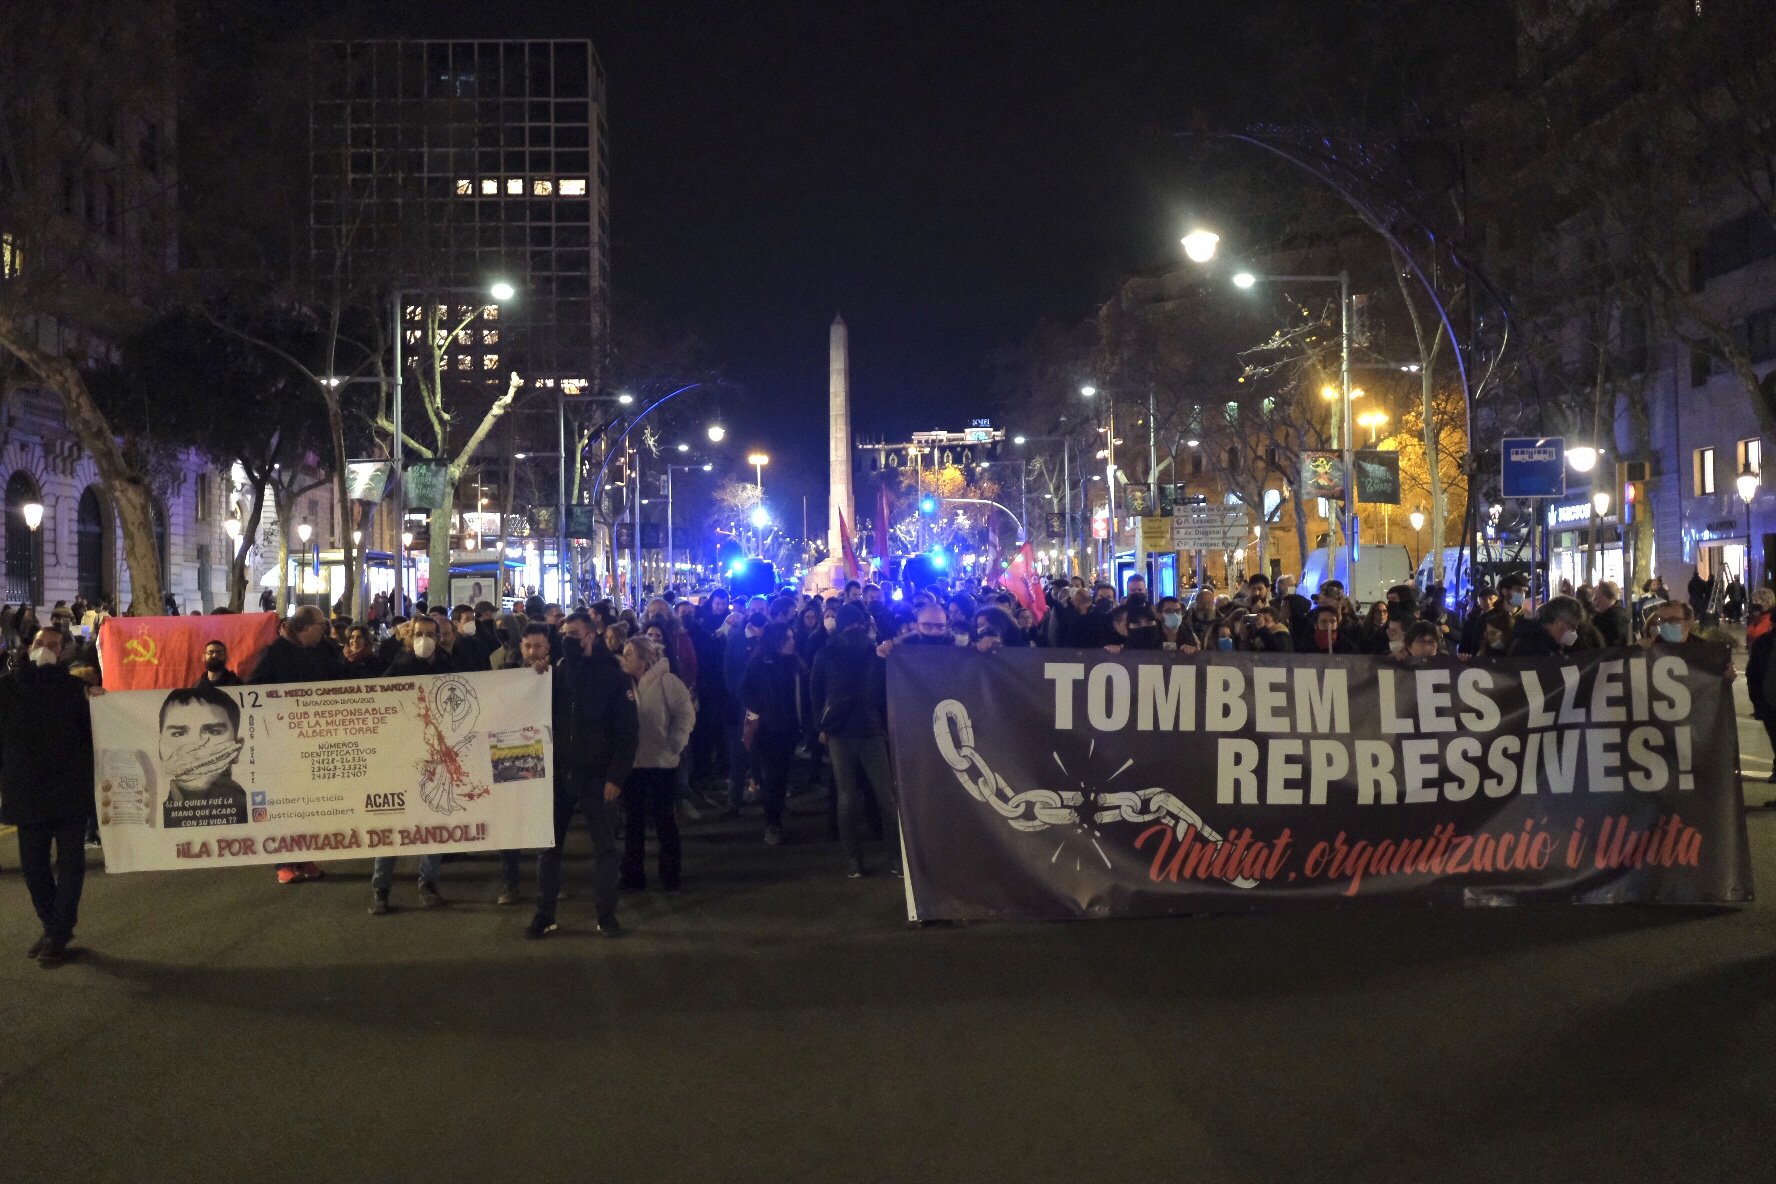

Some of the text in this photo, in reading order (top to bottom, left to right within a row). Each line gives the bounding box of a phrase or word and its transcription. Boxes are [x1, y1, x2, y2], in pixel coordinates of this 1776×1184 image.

[1195, 528, 1222, 537] Diagonal
[285, 689, 313, 697] MIEDO
[365, 685, 378, 693] DE
[1044, 655, 1693, 734] TOMBEM LES LLEIS
[239, 692, 263, 708] 12
[277, 707, 398, 721] 6 GUB RESPONSABLES
[288, 716, 388, 730] DE LA MUERTE DE
[297, 726, 379, 739] ALBERT TORRE
[300, 748, 377, 759] IDENTIFICATIVOS
[1216, 725, 1695, 806] REPRESSIVES!
[184, 799, 207, 807] QUIEN
[224, 797, 233, 805] LA
[267, 795, 344, 806] @albertjusticia
[365, 792, 406, 809] ACATS
[211, 807, 237, 816] ACABO
[268, 808, 355, 821] justiciajustaalbert
[181, 820, 197, 828] CON
[217, 836, 257, 857] POR
[262, 828, 361, 854] CANVIARÀ
[367, 829, 394, 848] DE
[399, 823, 486, 846] BÀNDOL!!
[1303, 815, 1560, 897] organització
[1565, 815, 1588, 870] i
[1593, 812, 1703, 870] lluita
